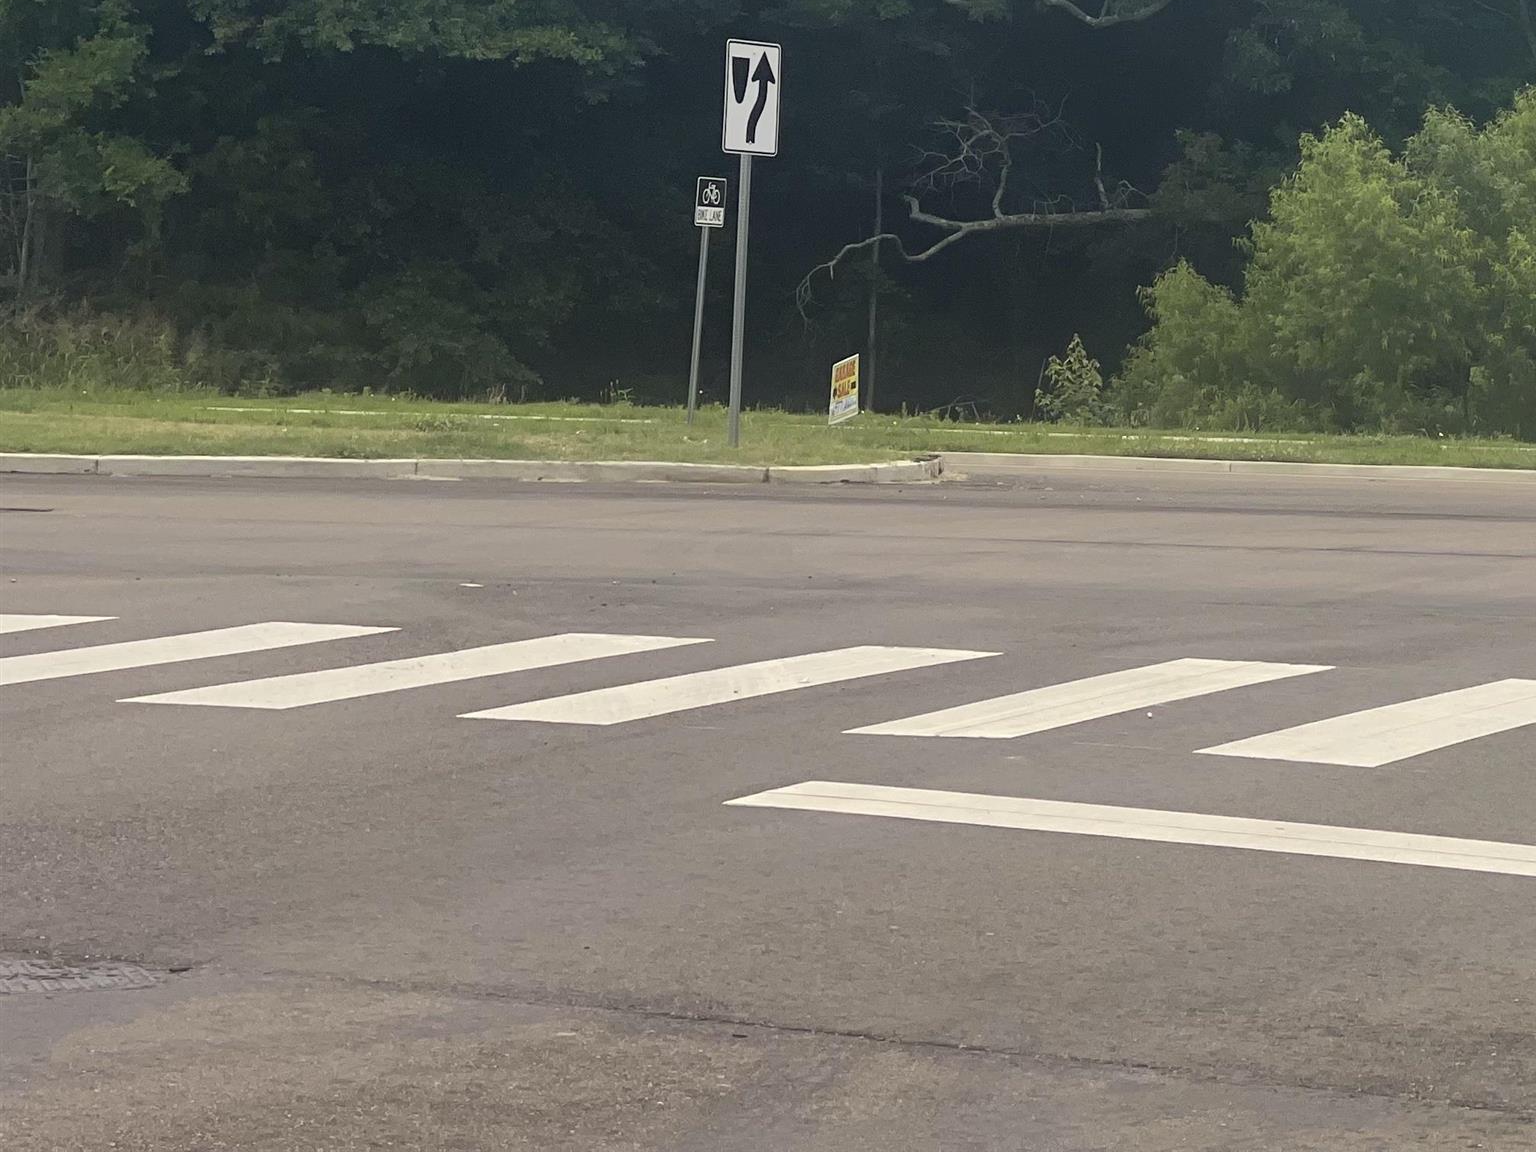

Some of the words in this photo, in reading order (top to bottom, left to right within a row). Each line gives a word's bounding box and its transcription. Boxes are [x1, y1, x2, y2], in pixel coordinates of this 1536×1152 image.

[697, 209, 708, 221] BIKE
[709, 209, 722, 222] LANE
[837, 380, 851, 399] SALE
